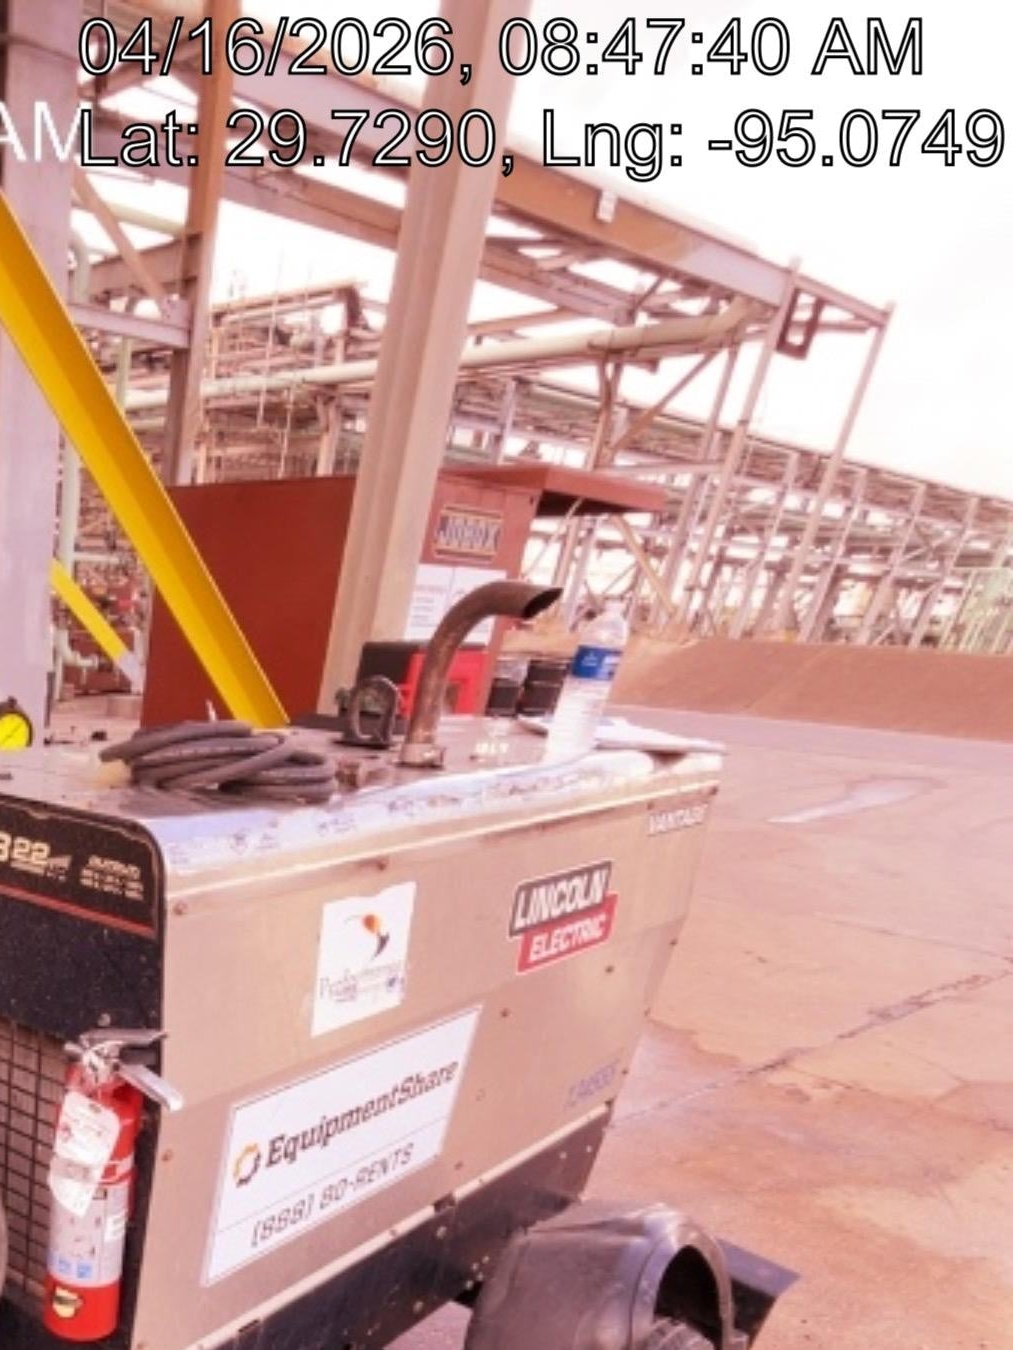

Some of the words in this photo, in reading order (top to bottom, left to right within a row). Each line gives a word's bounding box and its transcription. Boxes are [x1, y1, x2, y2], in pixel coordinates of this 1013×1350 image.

[514, 866, 608, 930] LINCOLN
[529, 913, 606, 962] ELECTRIC
[266, 1061, 458, 1169] EquipmentShare
